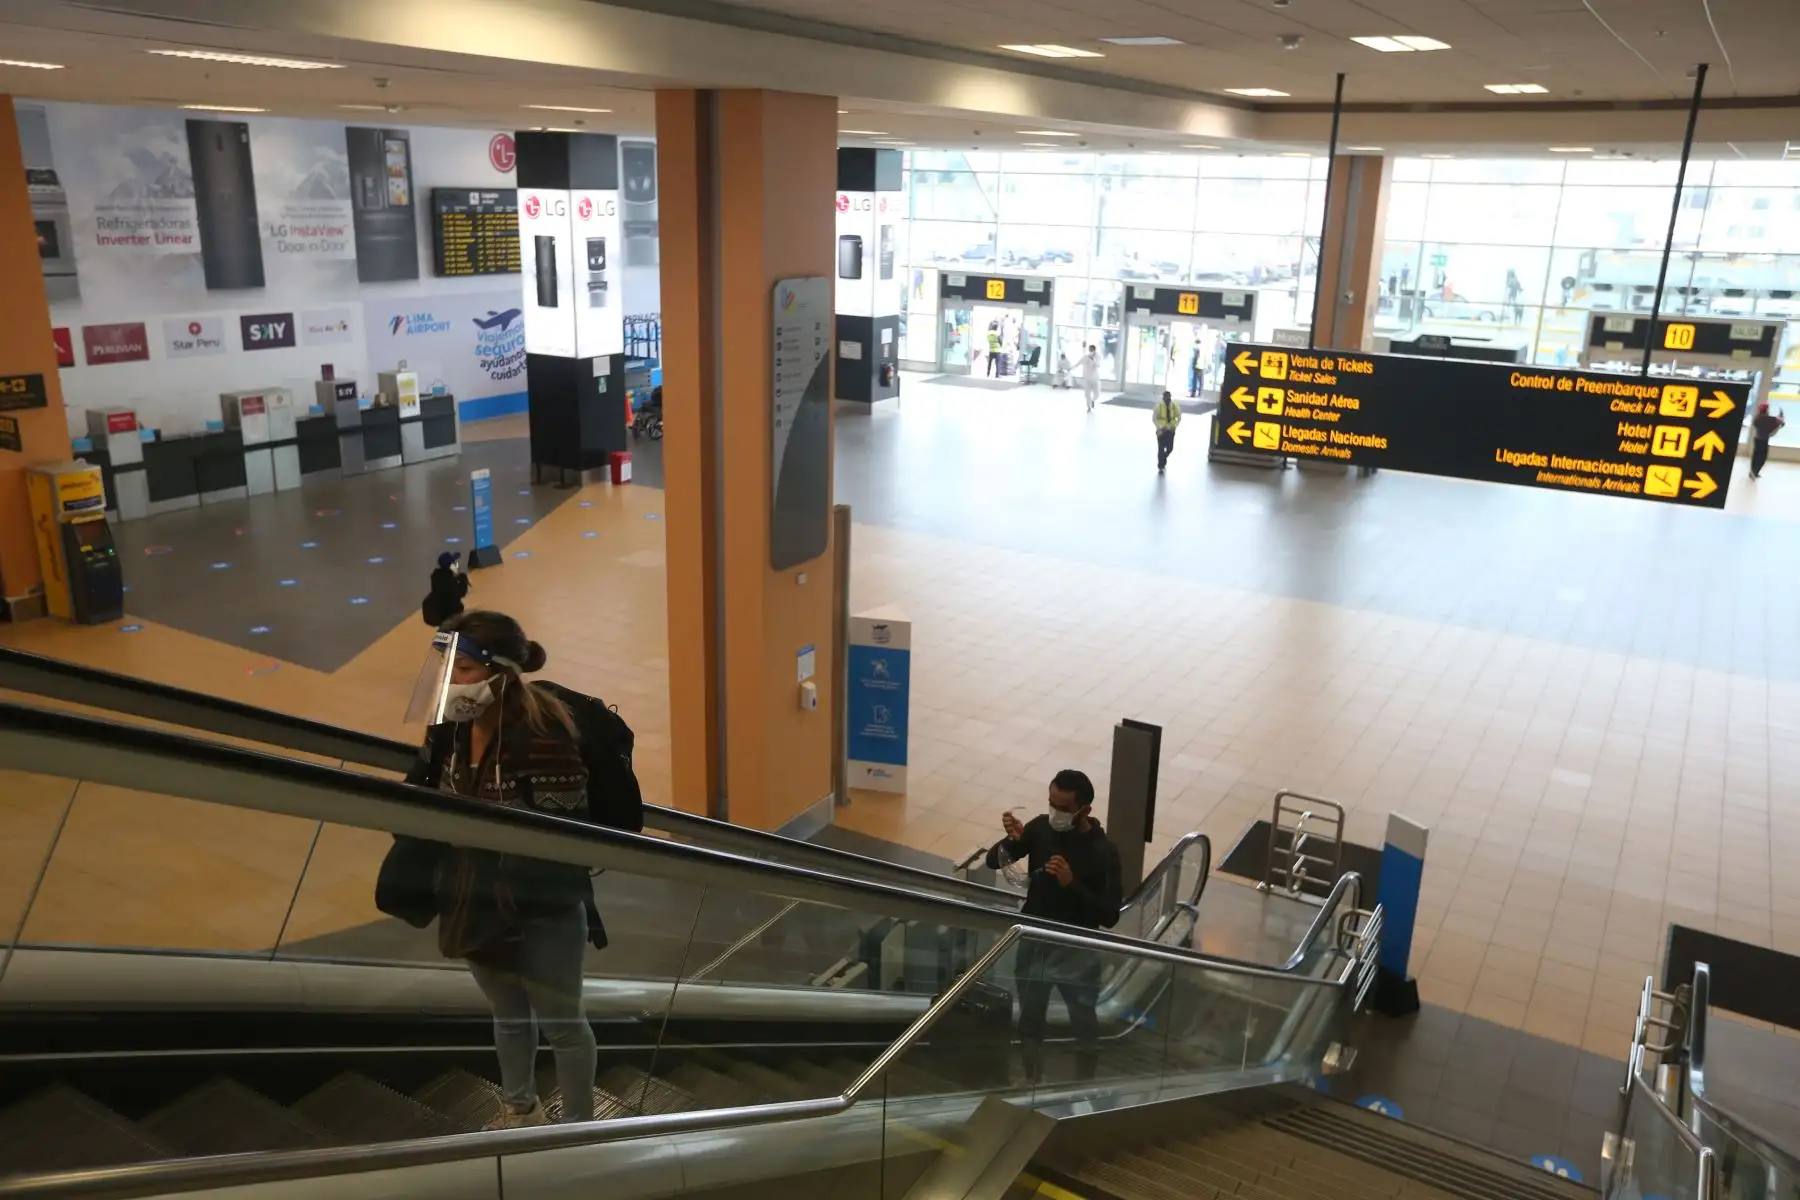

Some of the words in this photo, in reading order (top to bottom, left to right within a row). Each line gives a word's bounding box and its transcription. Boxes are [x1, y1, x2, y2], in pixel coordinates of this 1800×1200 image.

[545, 199, 566, 216] LG
[596, 199, 616, 217] LG
[853, 198, 872, 212] LG
[96, 216, 191, 232] Refrigeradoras
[270, 224, 288, 237] LG
[290, 223, 345, 237] InstaView
[96, 232, 151, 246] Inverter
[155, 231, 193, 245] Linear
[989, 282, 1003, 297] 12
[1183, 295, 1196, 310] 11
[406, 312, 434, 323] LIMA
[249, 322, 287, 341] SKY
[406, 320, 451, 336] AIRPORT
[172, 339, 195, 350] Star
[1671, 328, 1691, 346] 10
[92, 343, 143, 356] PERUVIAN
[1290, 354, 1319, 369] Venta
[1320, 357, 1335, 371] de
[1337, 358, 1374, 375] Tickets
[1289, 371, 1313, 384] Ticket
[1312, 373, 1337, 386] Sales
[1510, 372, 1555, 390] Control
[1556, 376, 1574, 392] de
[1575, 378, 1660, 400] Preembarque
[1286, 390, 1328, 407] Sanidad
[1328, 392, 1360, 411] Aérea
[1610, 399, 1642, 413] Check
[1644, 402, 1656, 415] In
[1284, 406, 1311, 419] Health
[1312, 408, 1342, 422] Center
[1282, 424, 1328, 442] Llegadas
[1329, 430, 1388, 449] Nacionales
[1617, 422, 1653, 439] Hotel
[1281, 440, 1321, 456] Domestic
[1320, 444, 1353, 460] Arrivals
[1618, 440, 1649, 454] Hotel
[1495, 448, 1549, 468] Llegadas
[1550, 454, 1644, 479] Internacionales
[1536, 471, 1602, 489] Internationals
[1602, 477, 1641, 494] Arrivals
